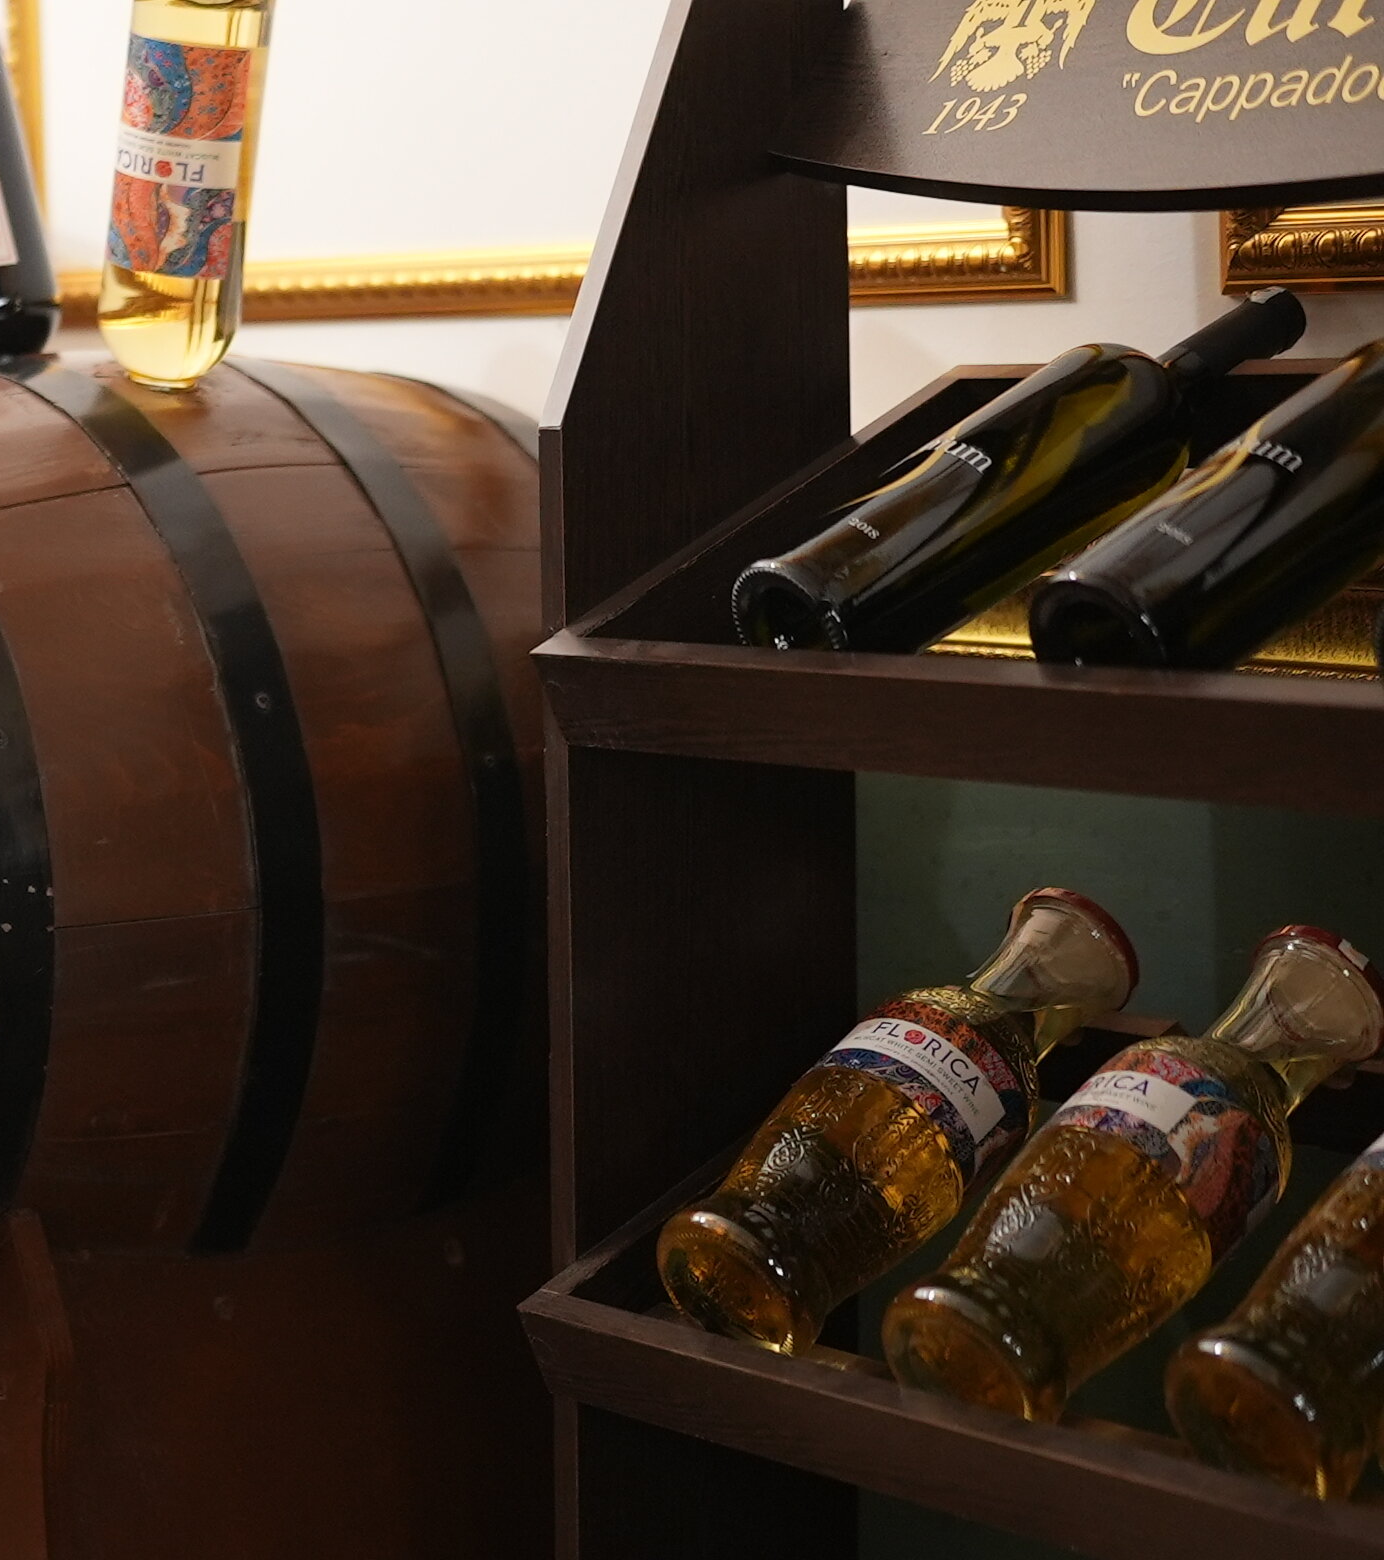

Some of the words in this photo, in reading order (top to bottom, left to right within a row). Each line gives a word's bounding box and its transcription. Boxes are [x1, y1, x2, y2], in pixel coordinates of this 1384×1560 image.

[922, 92, 1027, 135] 1943
[1122, 54, 1384, 123] "Cappado
[872, 1021, 983, 1097] FLORICA
[916, 1051, 936, 1069] SEMI
[937, 1066, 965, 1095] SWEET
